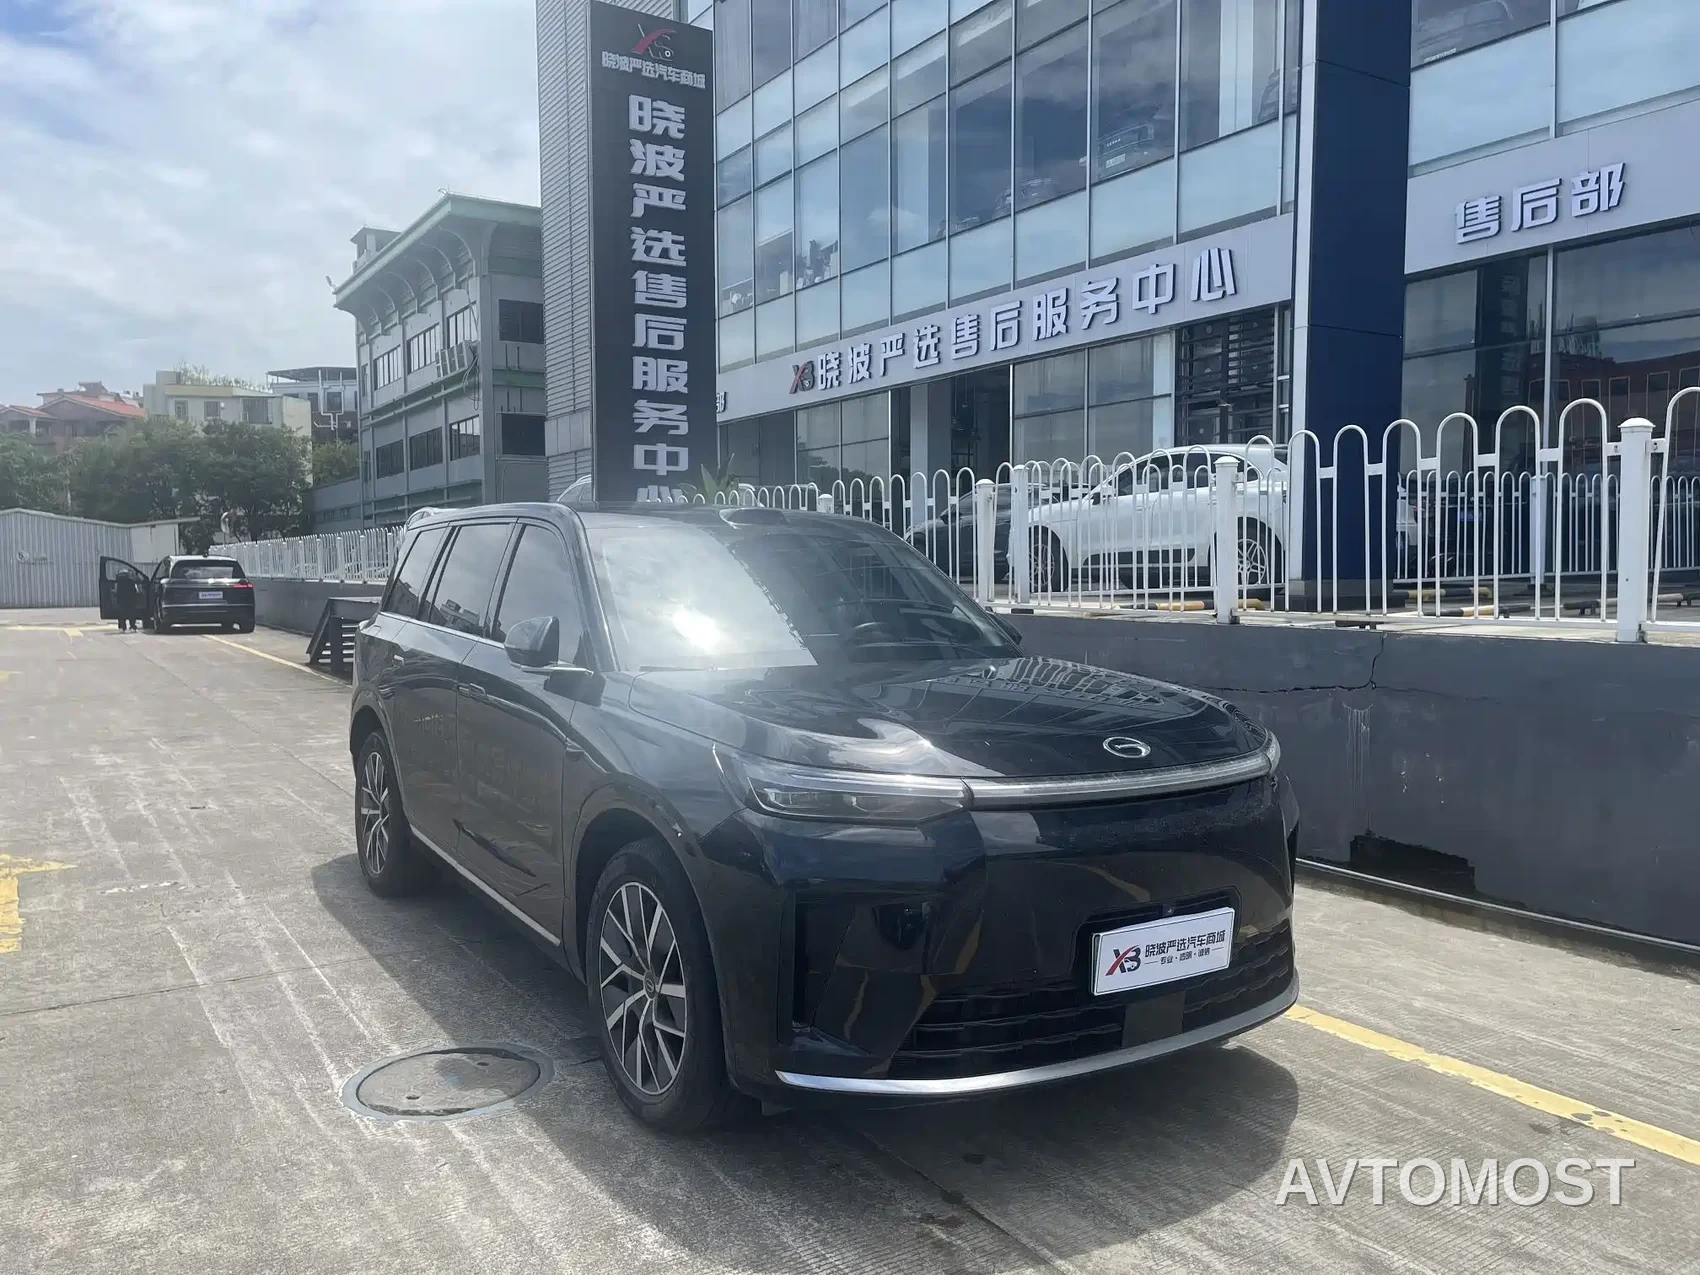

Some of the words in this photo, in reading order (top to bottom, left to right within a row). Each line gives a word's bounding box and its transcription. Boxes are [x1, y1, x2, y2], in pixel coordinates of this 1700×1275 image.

[601, 51, 706, 89] 晓波严选汽车商城
[1454, 162, 1625, 244] 售后部
[817, 247, 1237, 391] 晓波严选售后服务中心
[1144, 930, 1225, 957] 晓波严选汽车商城
